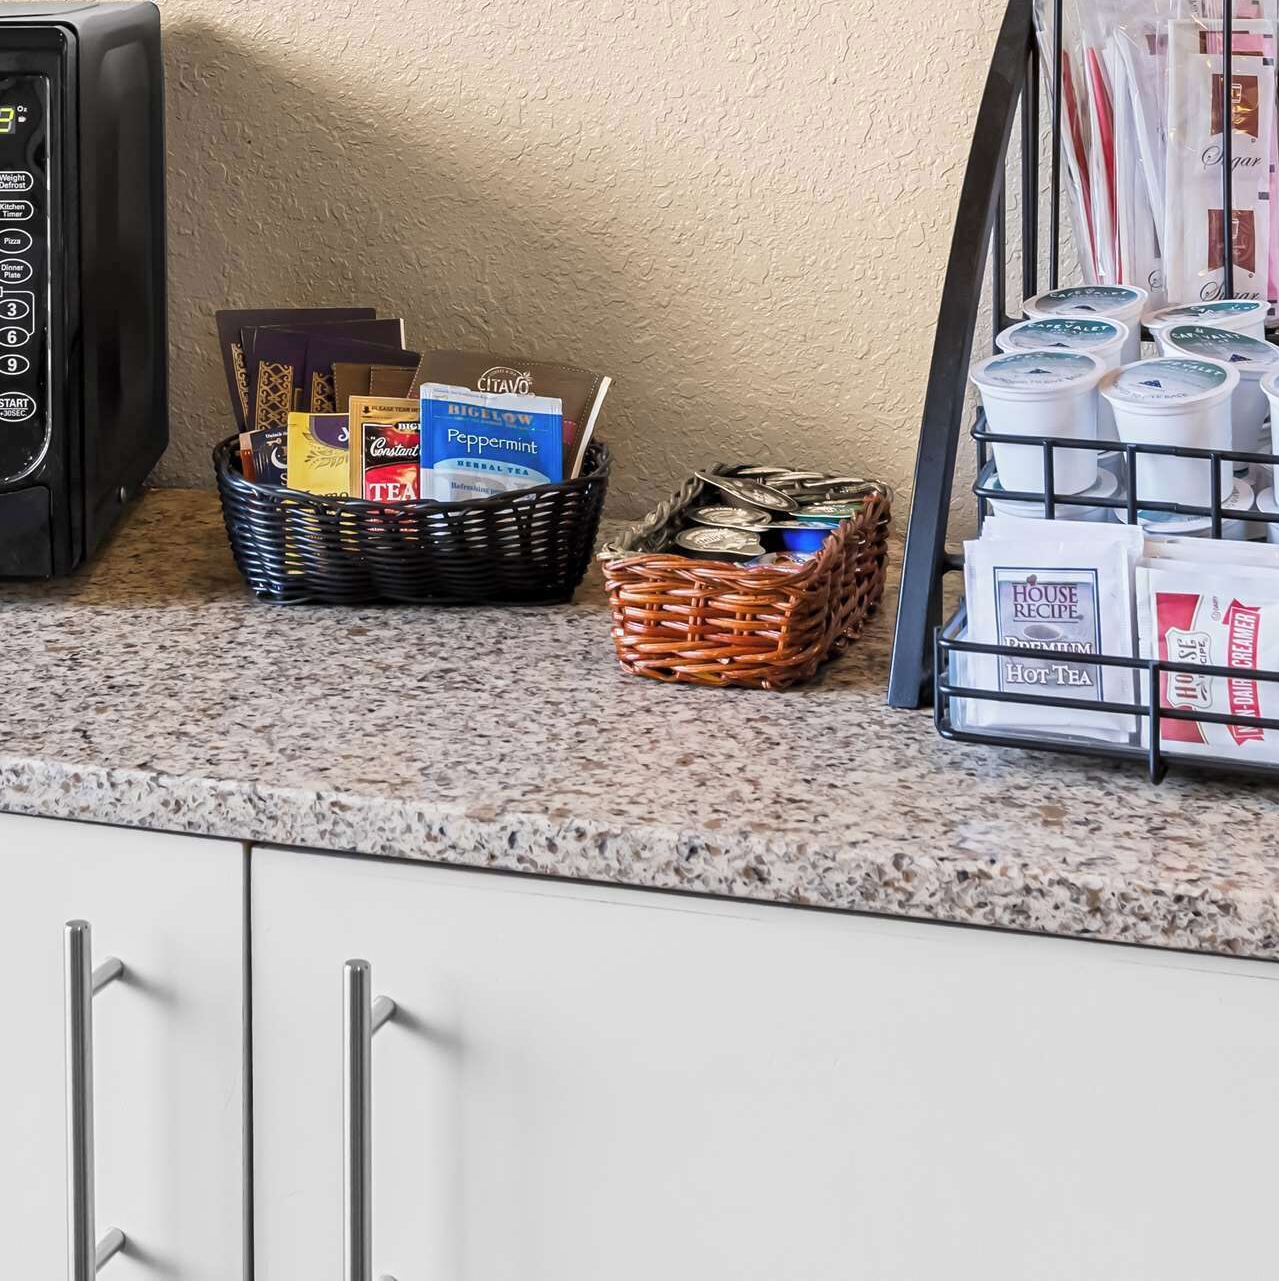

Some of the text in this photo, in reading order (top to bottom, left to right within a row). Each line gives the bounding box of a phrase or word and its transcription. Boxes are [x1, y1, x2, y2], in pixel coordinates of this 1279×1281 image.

[1201, 145, 1262, 171] Sgar
[0, 174, 25, 182] Weight
[7, 303, 17, 316] 3
[7, 330, 17, 344] 6
[7, 358, 17, 372] 9
[477, 376, 530, 395] CITAVO
[448, 429, 538, 455] Peppermint
[457, 460, 529, 476] HERBAL TEA
[368, 482, 417, 502] TEA
[1013, 585, 1078, 603] HOUSE
[1014, 603, 1079, 619] RECIPE
[1232, 612, 1257, 667] CREAMER
[1006, 664, 1093, 686] HOT TEA
[1175, 638, 1198, 699] HOSE
